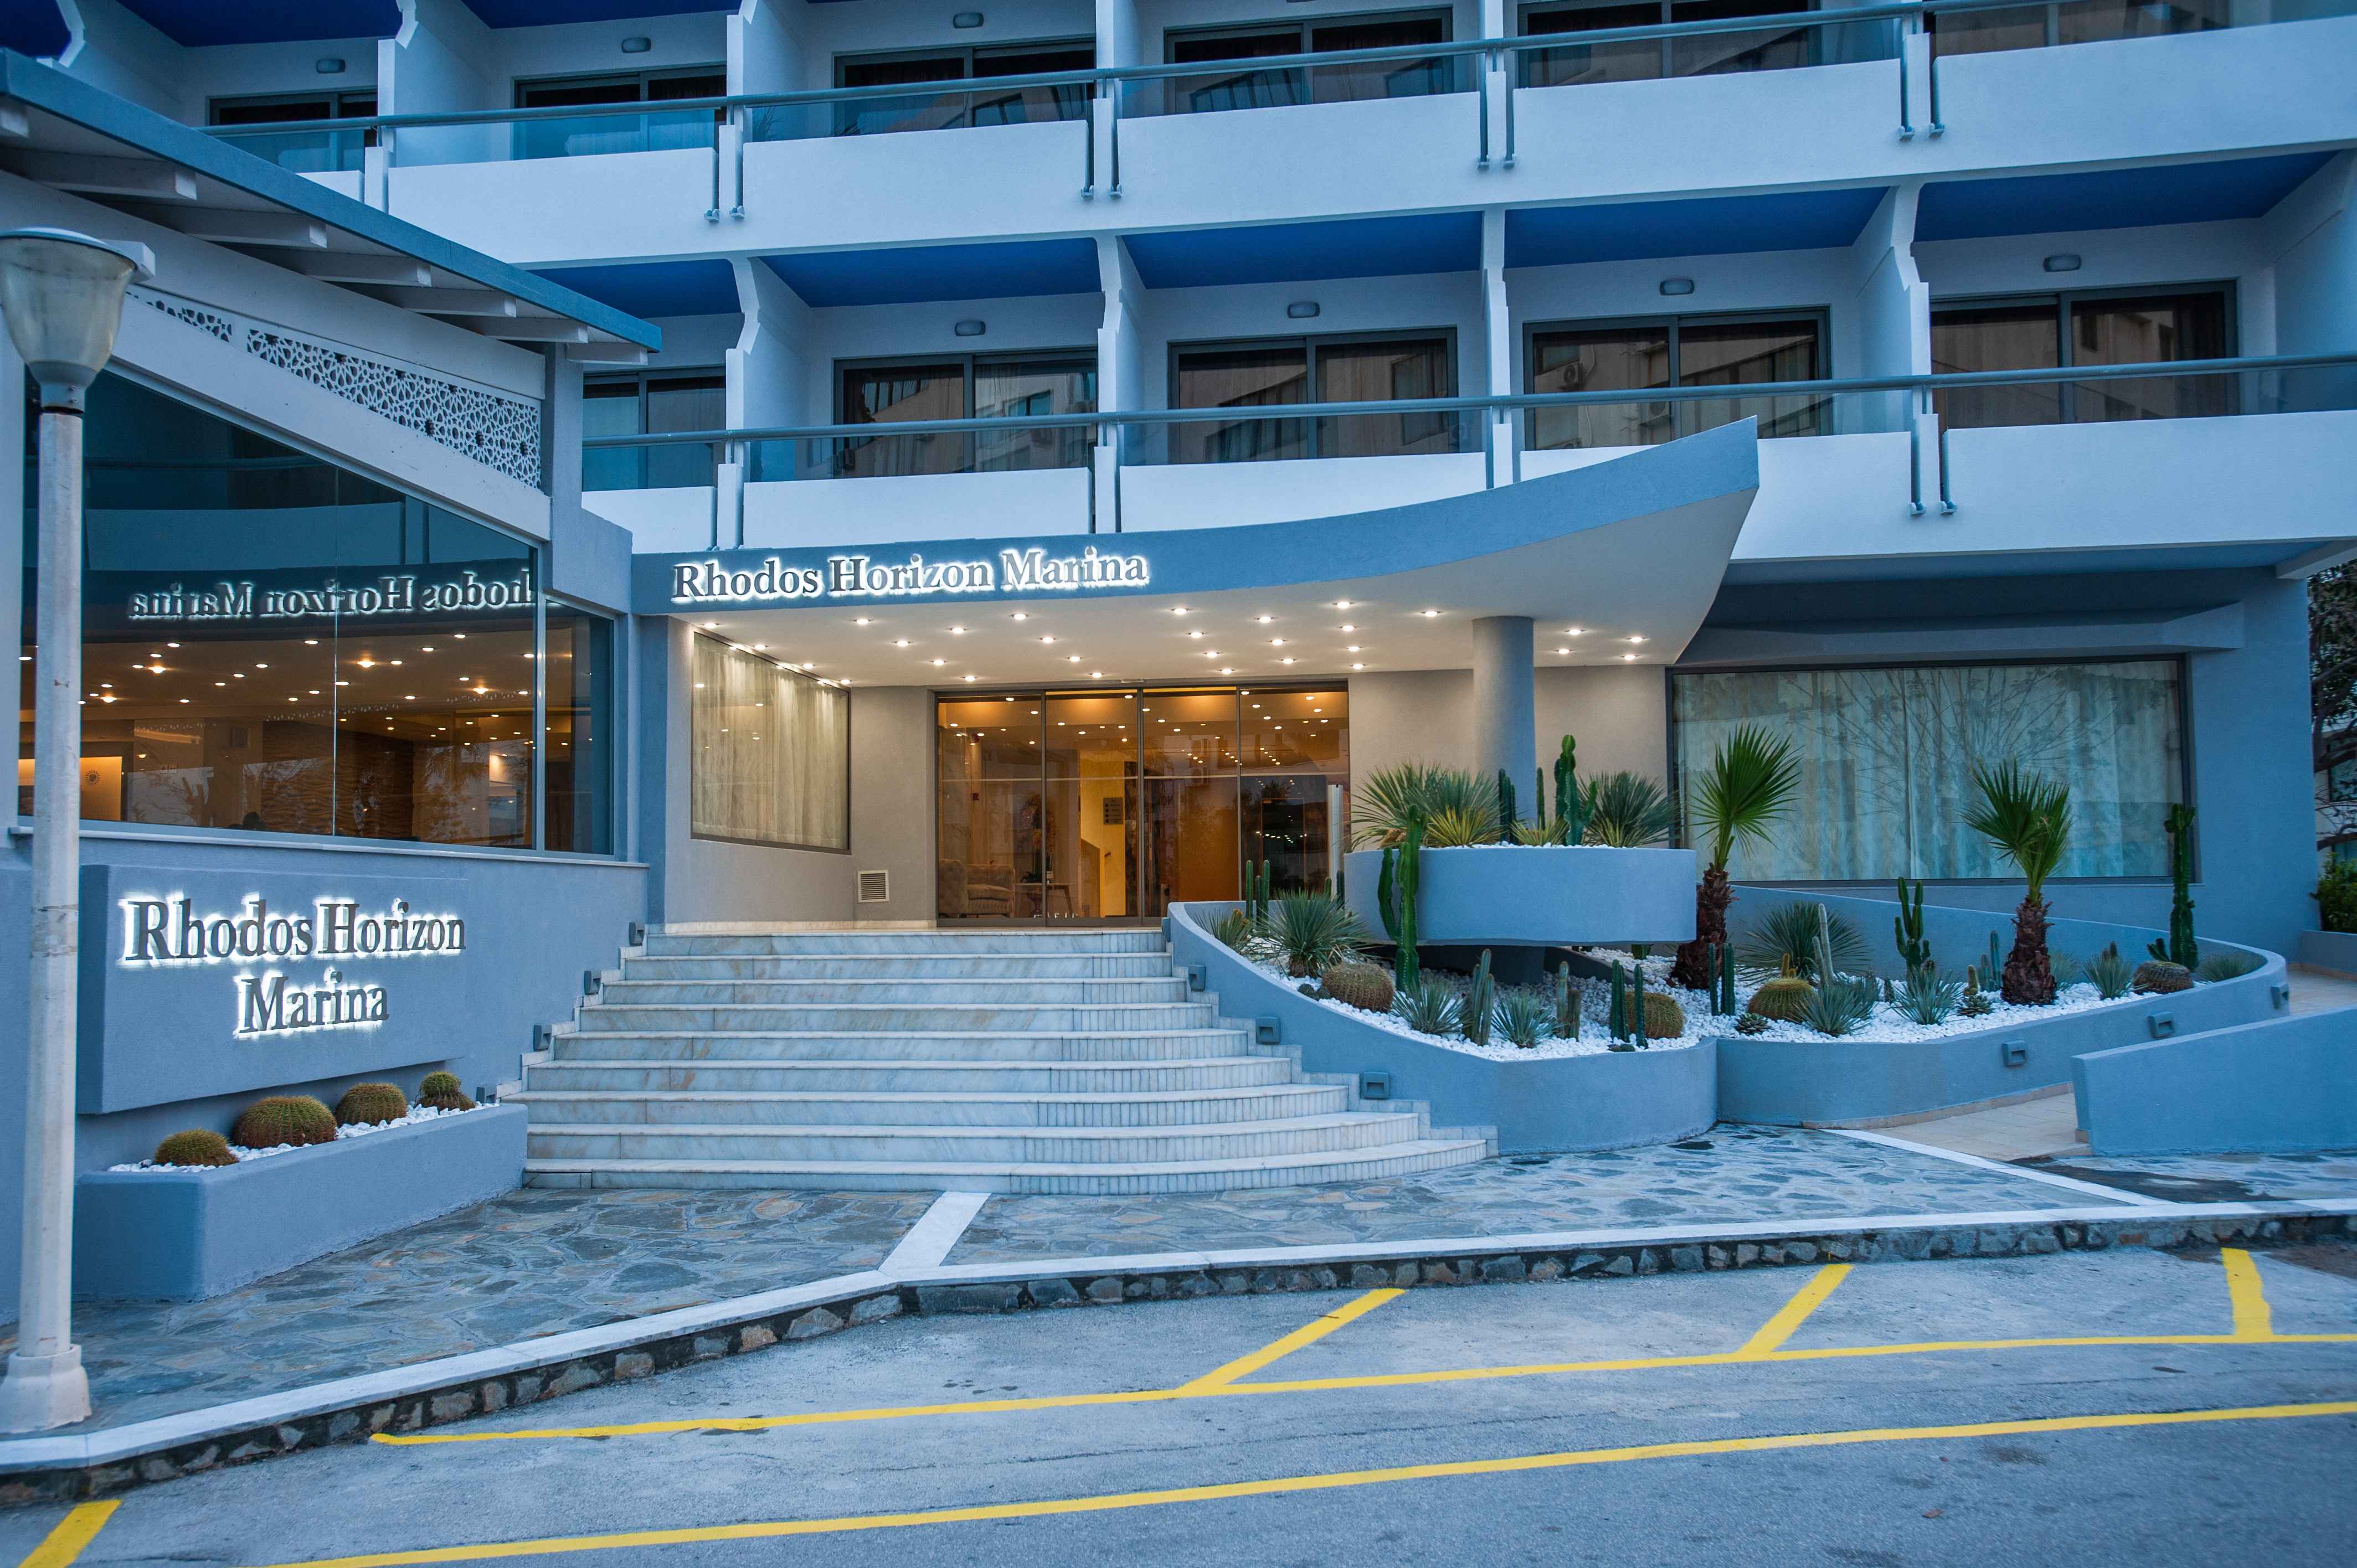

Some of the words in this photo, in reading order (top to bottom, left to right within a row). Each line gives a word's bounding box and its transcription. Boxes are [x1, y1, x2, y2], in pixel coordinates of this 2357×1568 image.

[673, 560, 818, 598] Rhodos
[830, 554, 991, 591] Horizon
[1002, 546, 1147, 585] Marina
[125, 898, 313, 961] Rhodos
[318, 901, 466, 953] Horizon
[239, 971, 389, 1033] Marina
